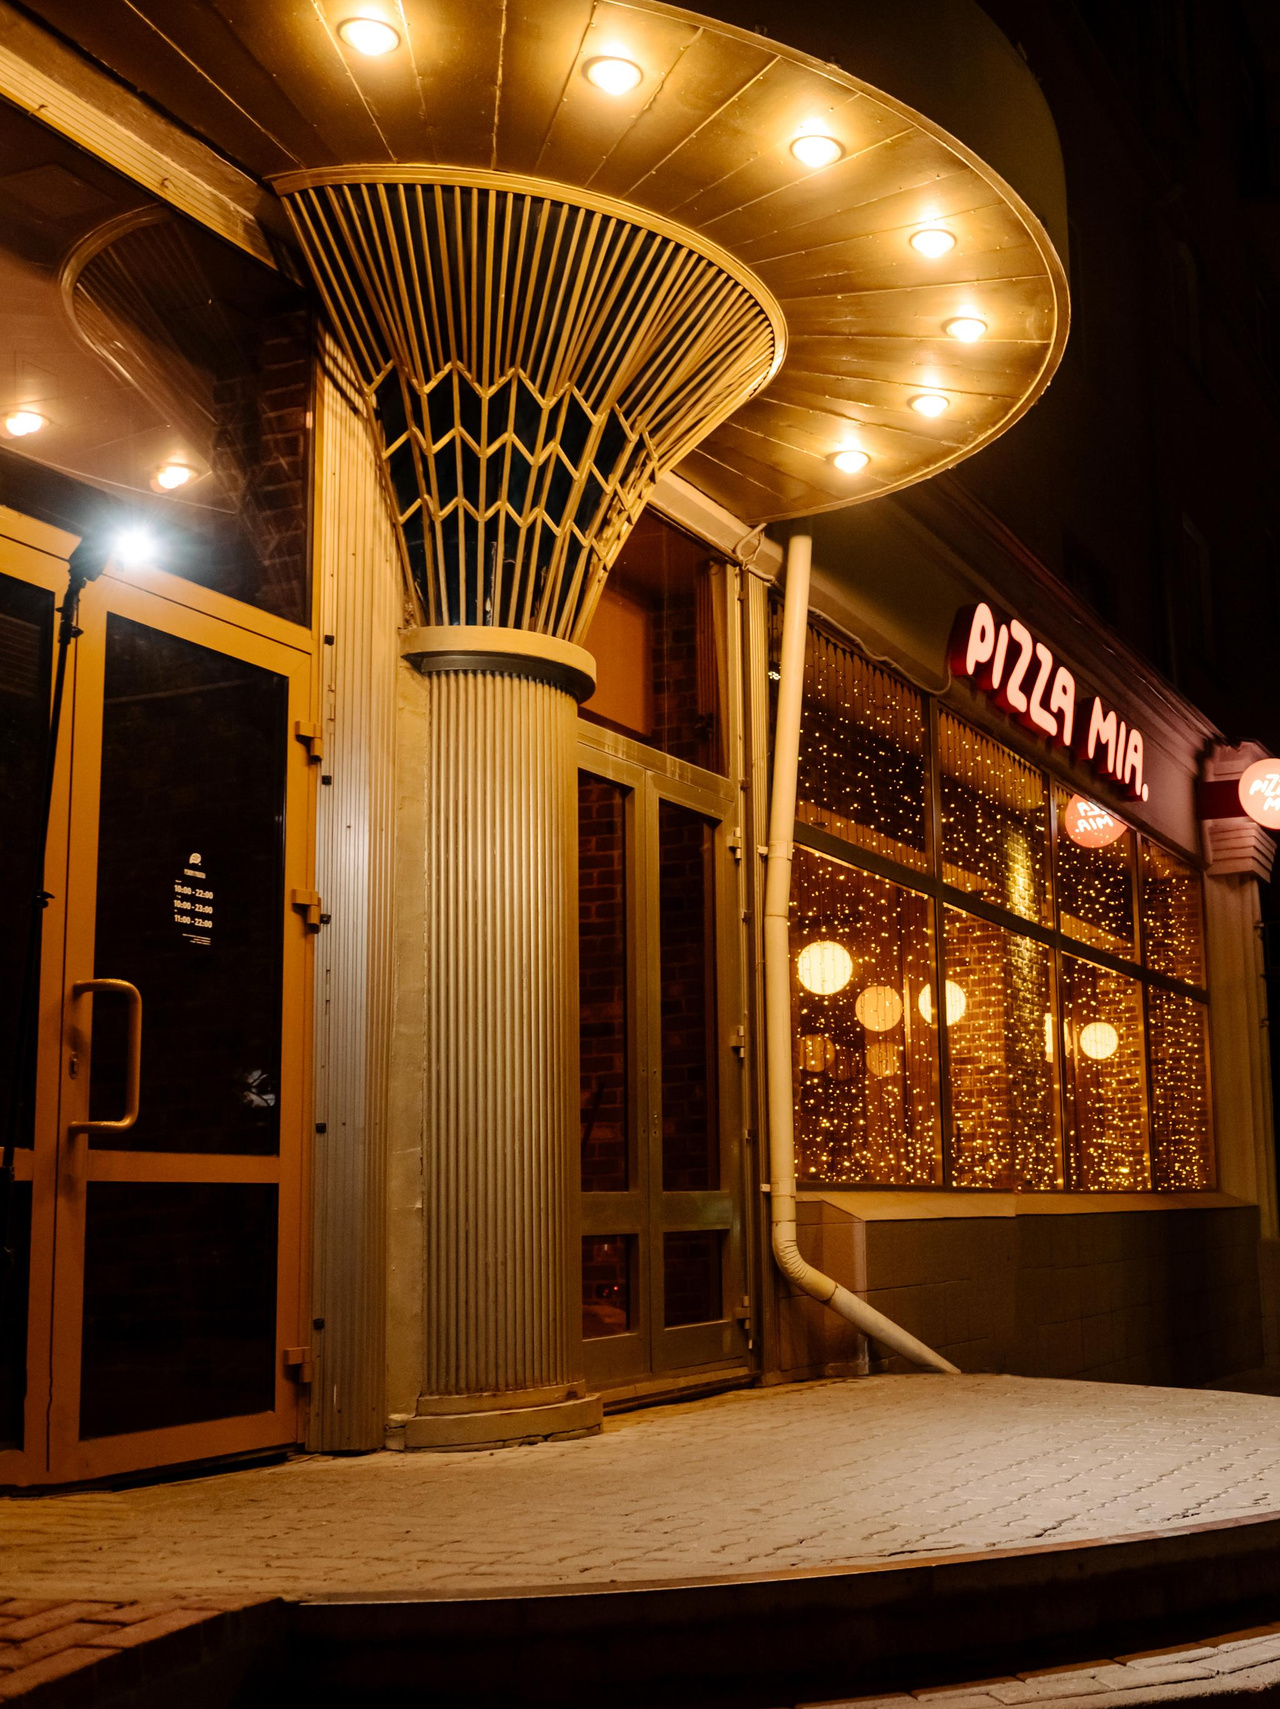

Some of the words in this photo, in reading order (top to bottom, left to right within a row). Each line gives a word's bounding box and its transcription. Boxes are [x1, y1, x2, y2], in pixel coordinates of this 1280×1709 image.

[966, 602, 1076, 746] PIZZA
[1087, 696, 1149, 802] MIA.
[174, 884, 192, 895] 10:00
[195, 889, 213, 899] 22:00
[173, 899, 192, 910] 10:00
[174, 914, 191, 924] 11:00
[194, 918, 213, 928] 22:00
